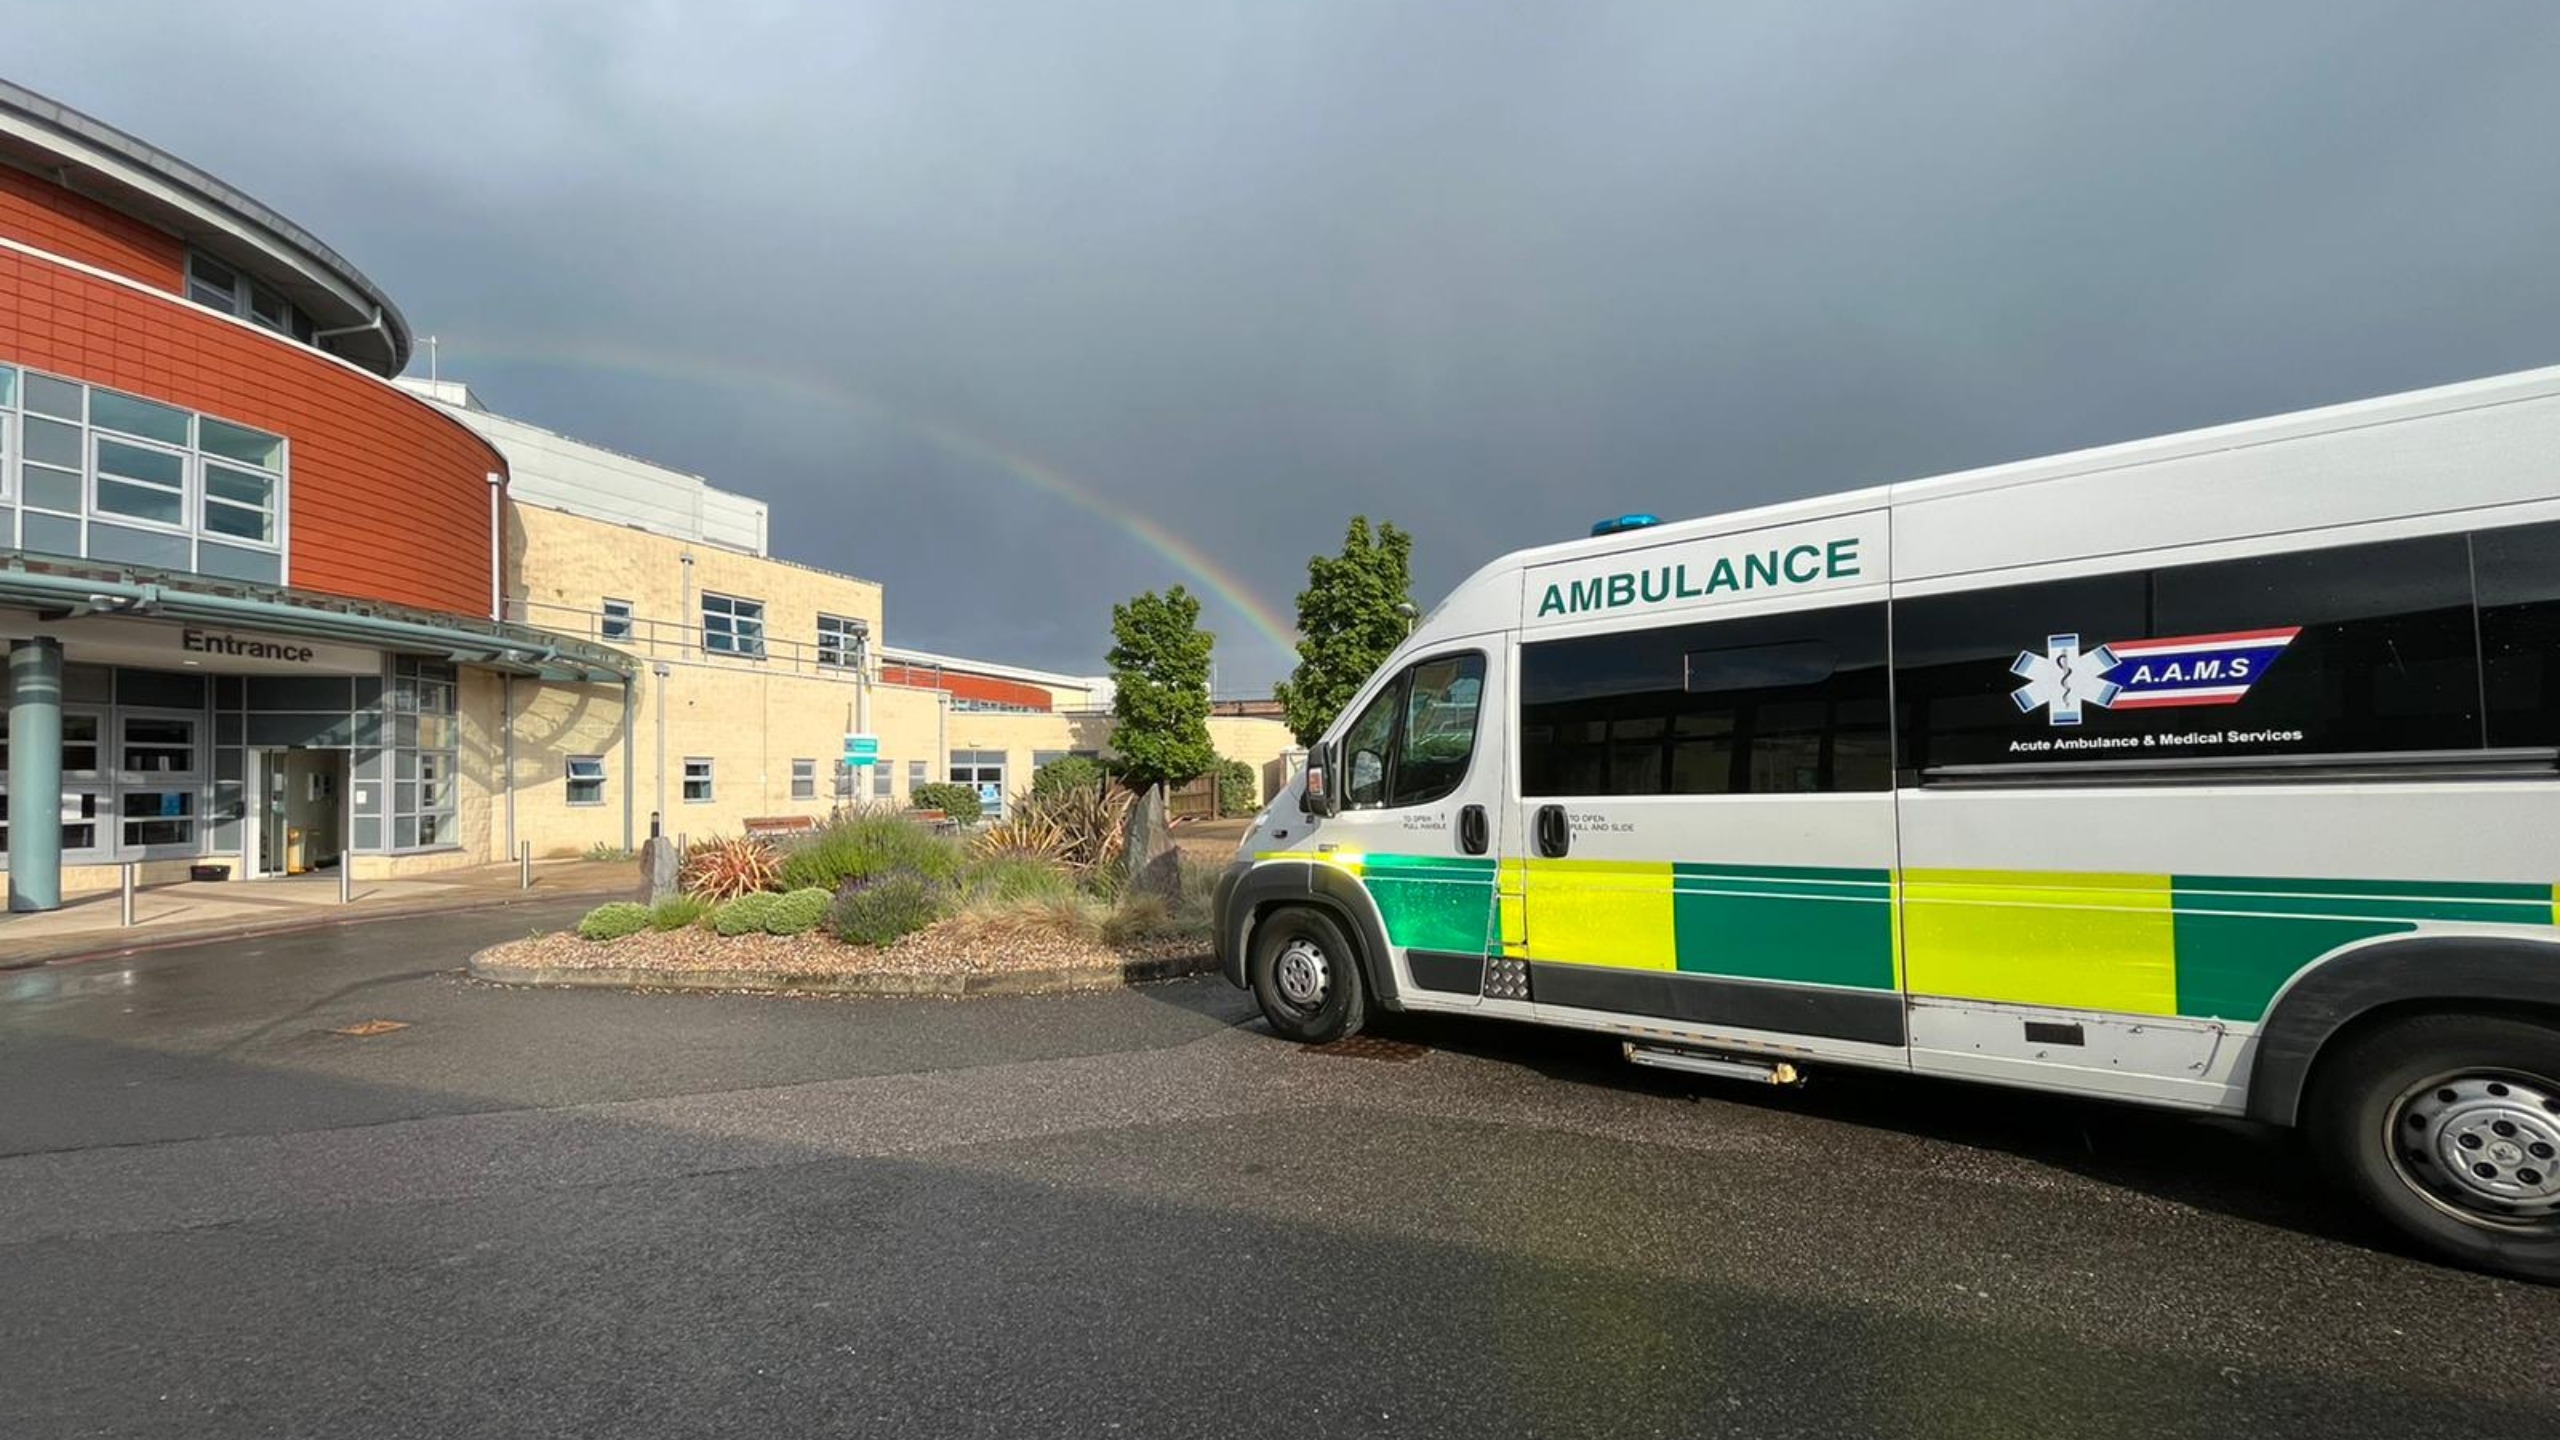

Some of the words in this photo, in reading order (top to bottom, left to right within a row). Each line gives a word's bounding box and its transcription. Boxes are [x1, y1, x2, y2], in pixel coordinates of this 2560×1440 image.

[1537, 538, 1861, 617] AMBULANCE
[182, 628, 313, 662] Entrance
[2131, 658, 2250, 684] A.A.M.S
[2009, 740, 2051, 752] Acute
[2053, 737, 2139, 749] Ambulance
[2143, 734, 2156, 746] &
[2160, 732, 2223, 746] Medical
[2227, 729, 2303, 743] Services
